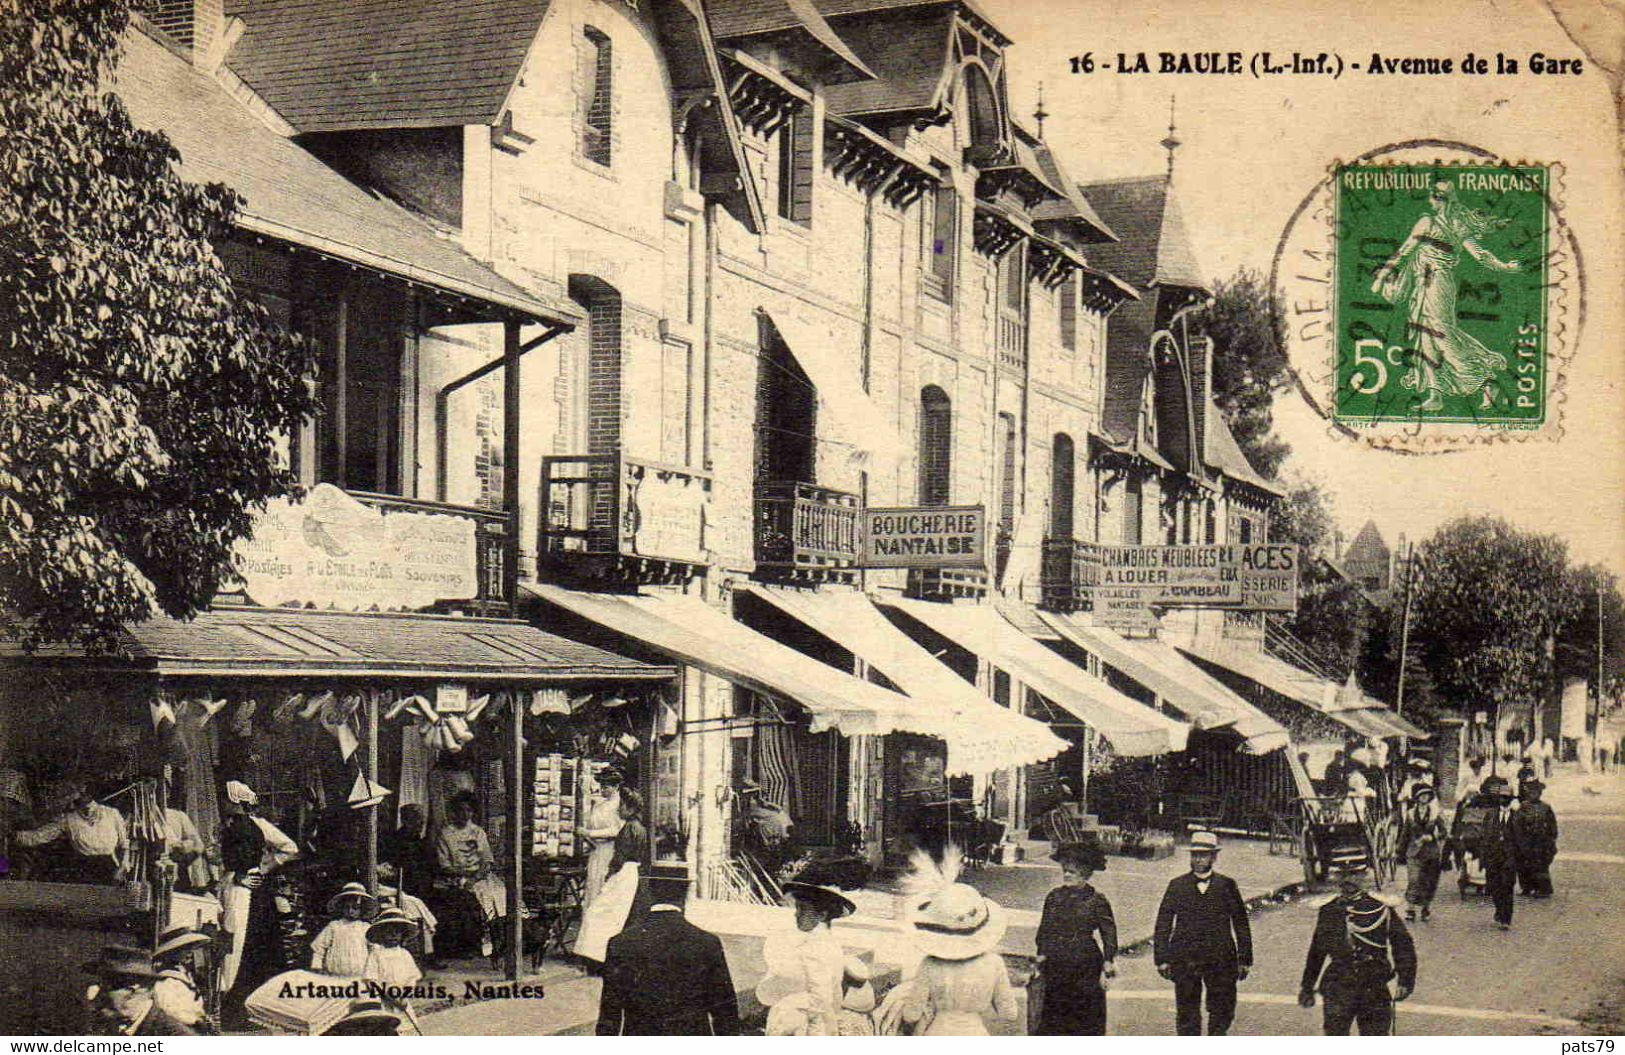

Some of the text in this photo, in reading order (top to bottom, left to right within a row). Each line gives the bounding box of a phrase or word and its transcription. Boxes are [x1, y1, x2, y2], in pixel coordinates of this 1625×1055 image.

[1516, 322, 1539, 408] POSTES
[872, 514, 977, 536] BOUCHERIE
[874, 536, 974, 555] NANTAISE
[1102, 548, 1158, 568] CHAMBRES
[1242, 545, 1294, 571] ACES
[1118, 570, 1168, 584] LOUER
